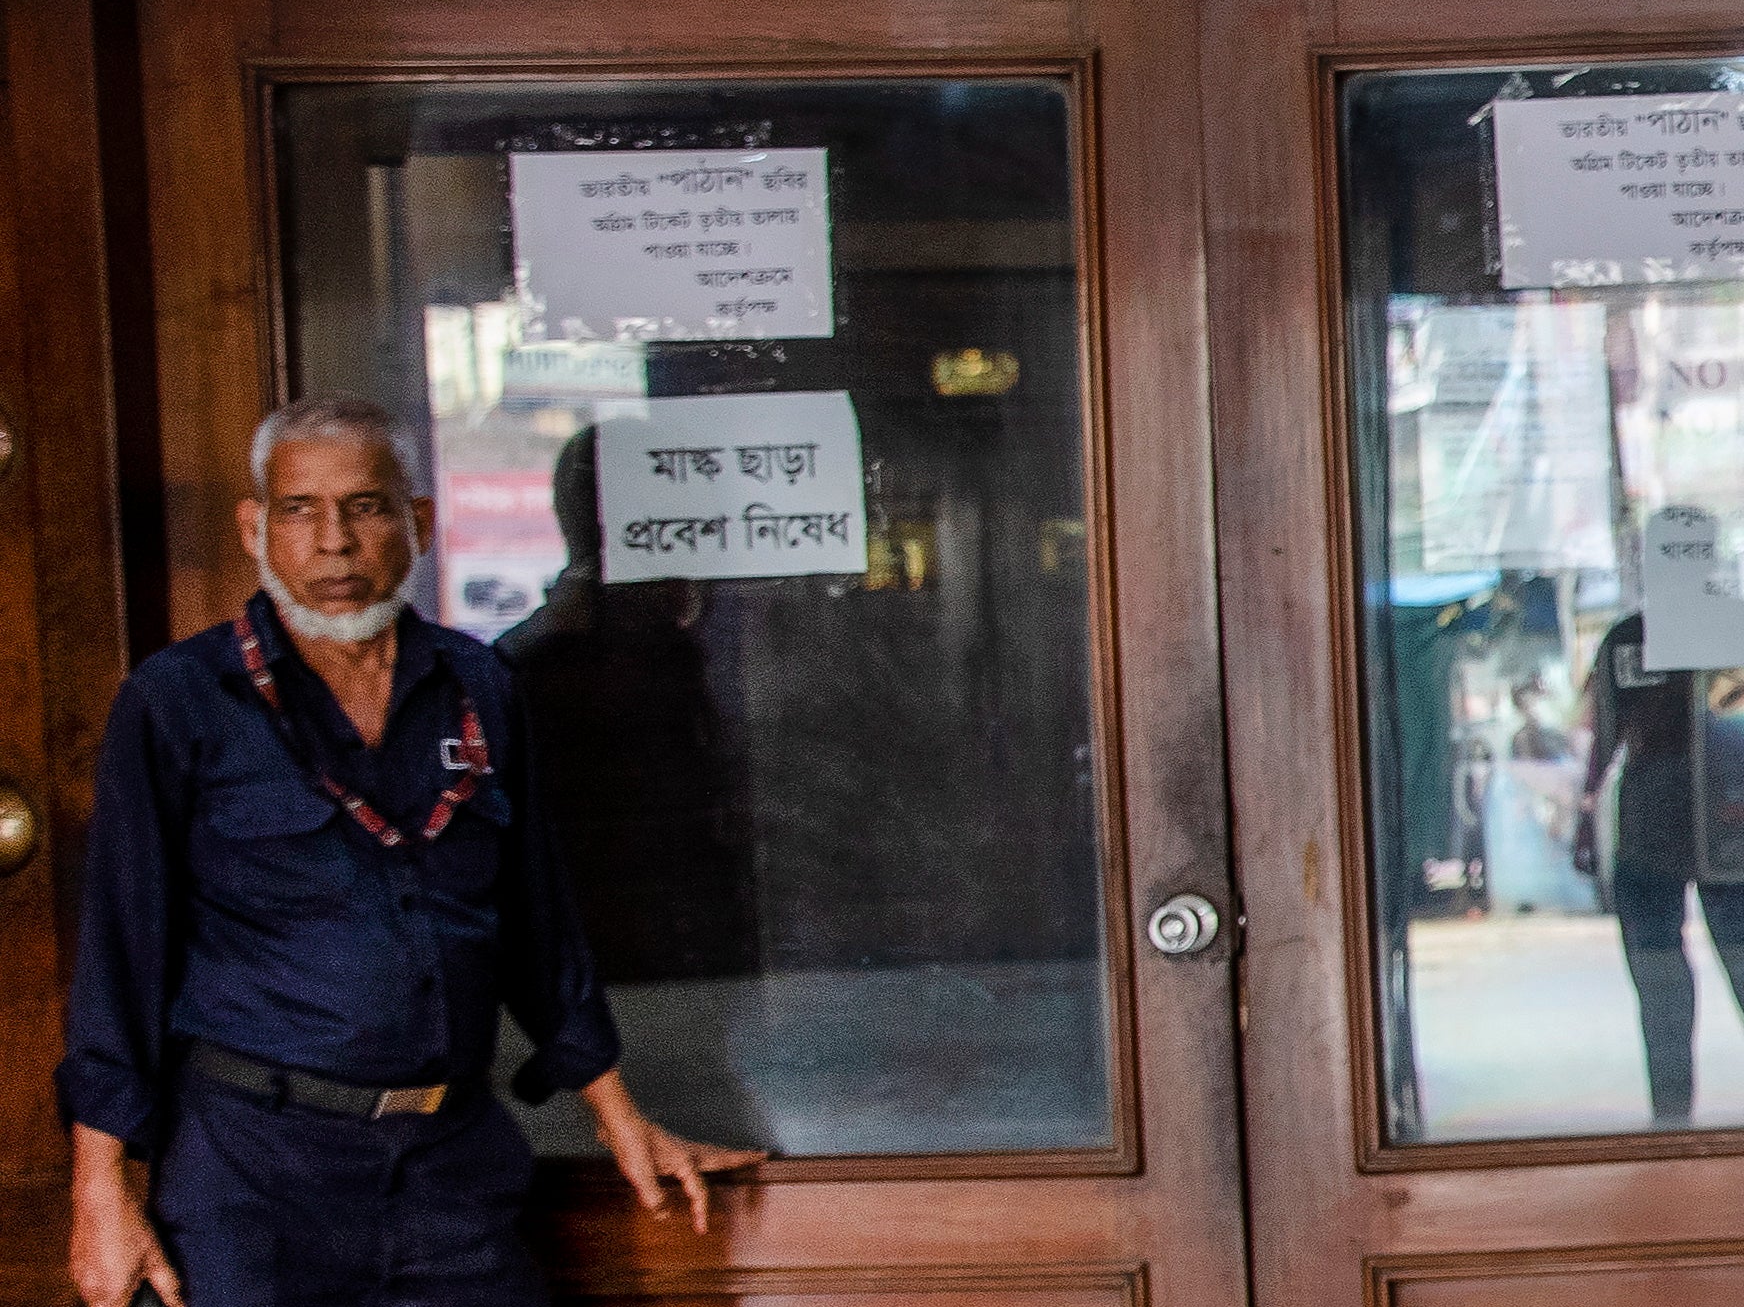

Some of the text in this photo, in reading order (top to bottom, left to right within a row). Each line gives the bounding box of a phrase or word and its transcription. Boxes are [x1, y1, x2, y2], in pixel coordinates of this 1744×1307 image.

[1617, 149, 1669, 171] টিকেট
[1667, 358, 1729, 391] NO
[733, 442, 822, 488] ছাড়া
[623, 502, 851, 554] প্রবেশ নিষেধ
